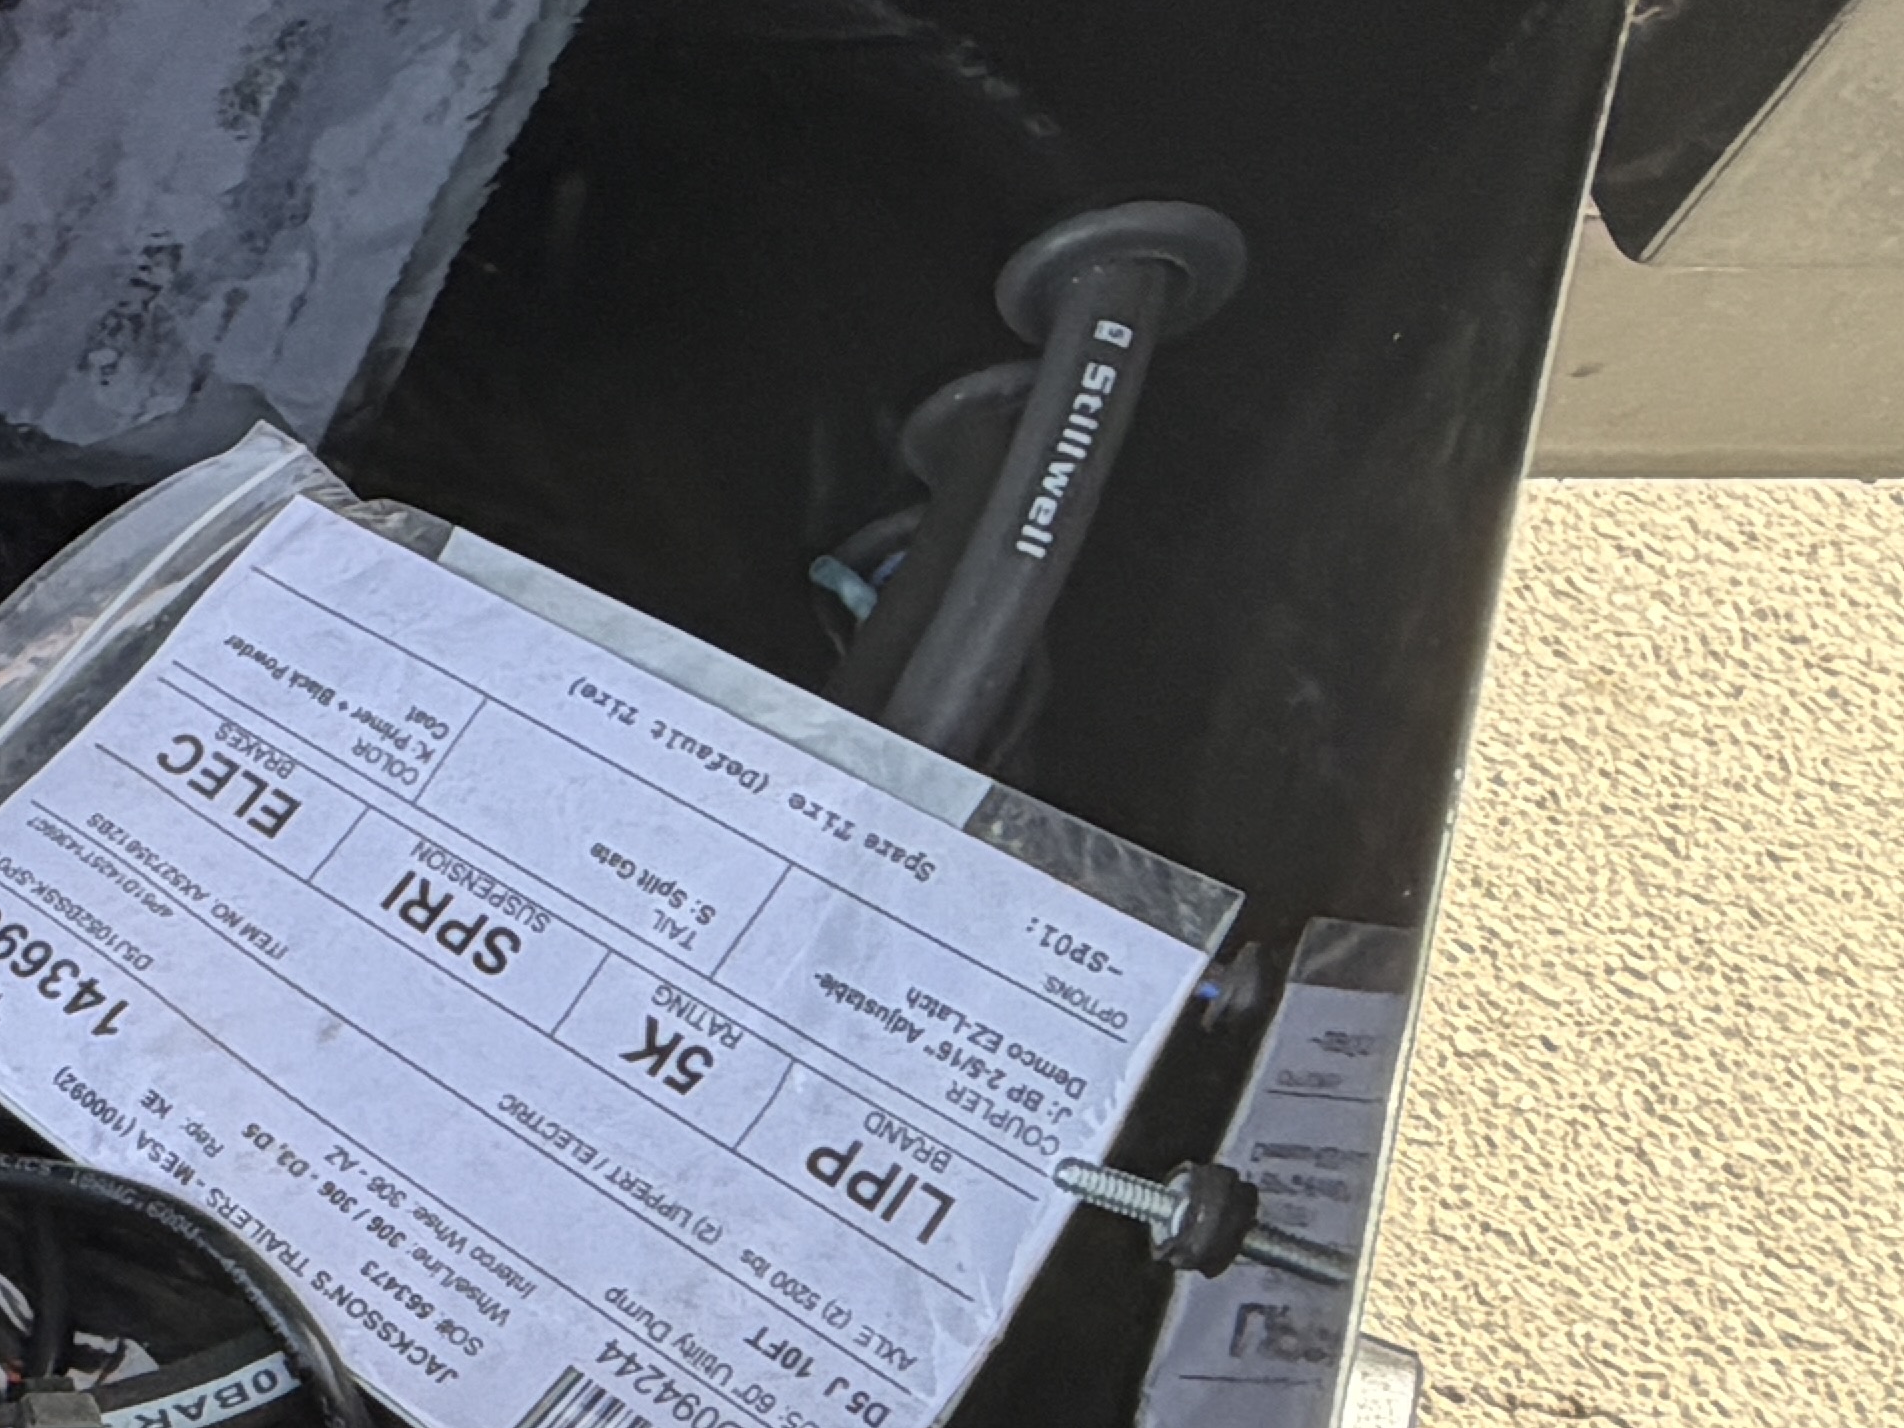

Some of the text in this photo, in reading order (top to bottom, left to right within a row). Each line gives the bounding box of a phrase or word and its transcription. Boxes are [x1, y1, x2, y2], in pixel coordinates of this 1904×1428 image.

[1017, 362, 1117, 560] Stillwell
[223, 634, 436, 764] K: Primer Black Powder
[410, 703, 452, 743] Coat
[214, 716, 300, 780] BRAKES
[350, 736, 420, 786] COLOR
[567, 676, 936, 883] Spare Tire (Default Tire)
[156, 734, 302, 840] ELEC
[210, 898, 244, 928] NO.
[410, 833, 555, 934] SUSPENSION
[590, 842, 717, 926] S: Split Gate
[238, 922, 290, 960] ITEM
[380, 870, 522, 976] SPRI
[652, 908, 698, 952] TAIL
[1026, 916, 1124, 976] -SP01:
[650, 977, 744, 1050] RATING
[814, 972, 926, 1044] Adjustable-
[906, 986, 1088, 1101] Demco EZ-Latch
[618, 1014, 714, 1096] 5K
[52, 1065, 196, 1186] MESA (100092)
[139, 1088, 225, 1159] Rep: KE
[944, 1080, 1060, 1156] COUPLER
[1006, 1084, 1045, 1113] BP
[1046, 1100, 1074, 1125] J:
[323, 1144, 360, 1172] AZ
[862, 1103, 959, 1174] BRAND
[241, 1122, 511, 1328] Whse/Line: 306 306 D3, D5
[805, 1140, 956, 1245] LIPP
[411, 1206, 468, 1255] Whse:
[496, 1094, 918, 1372] AXLE (2) 5200 lbs (2) LIPPERT ELECTRIC
[206, 1187, 460, 1384] JACKSSON'S TRAILERS
[360, 1260, 436, 1320] 563473
[468, 1245, 538, 1300] Interco
[593, 1286, 674, 1344] Dump
[670, 1332, 734, 1387] Utility
[742, 1326, 814, 1378] 10FT
[822, 1376, 850, 1398] J
[730, 1383, 777, 1415] 60"
